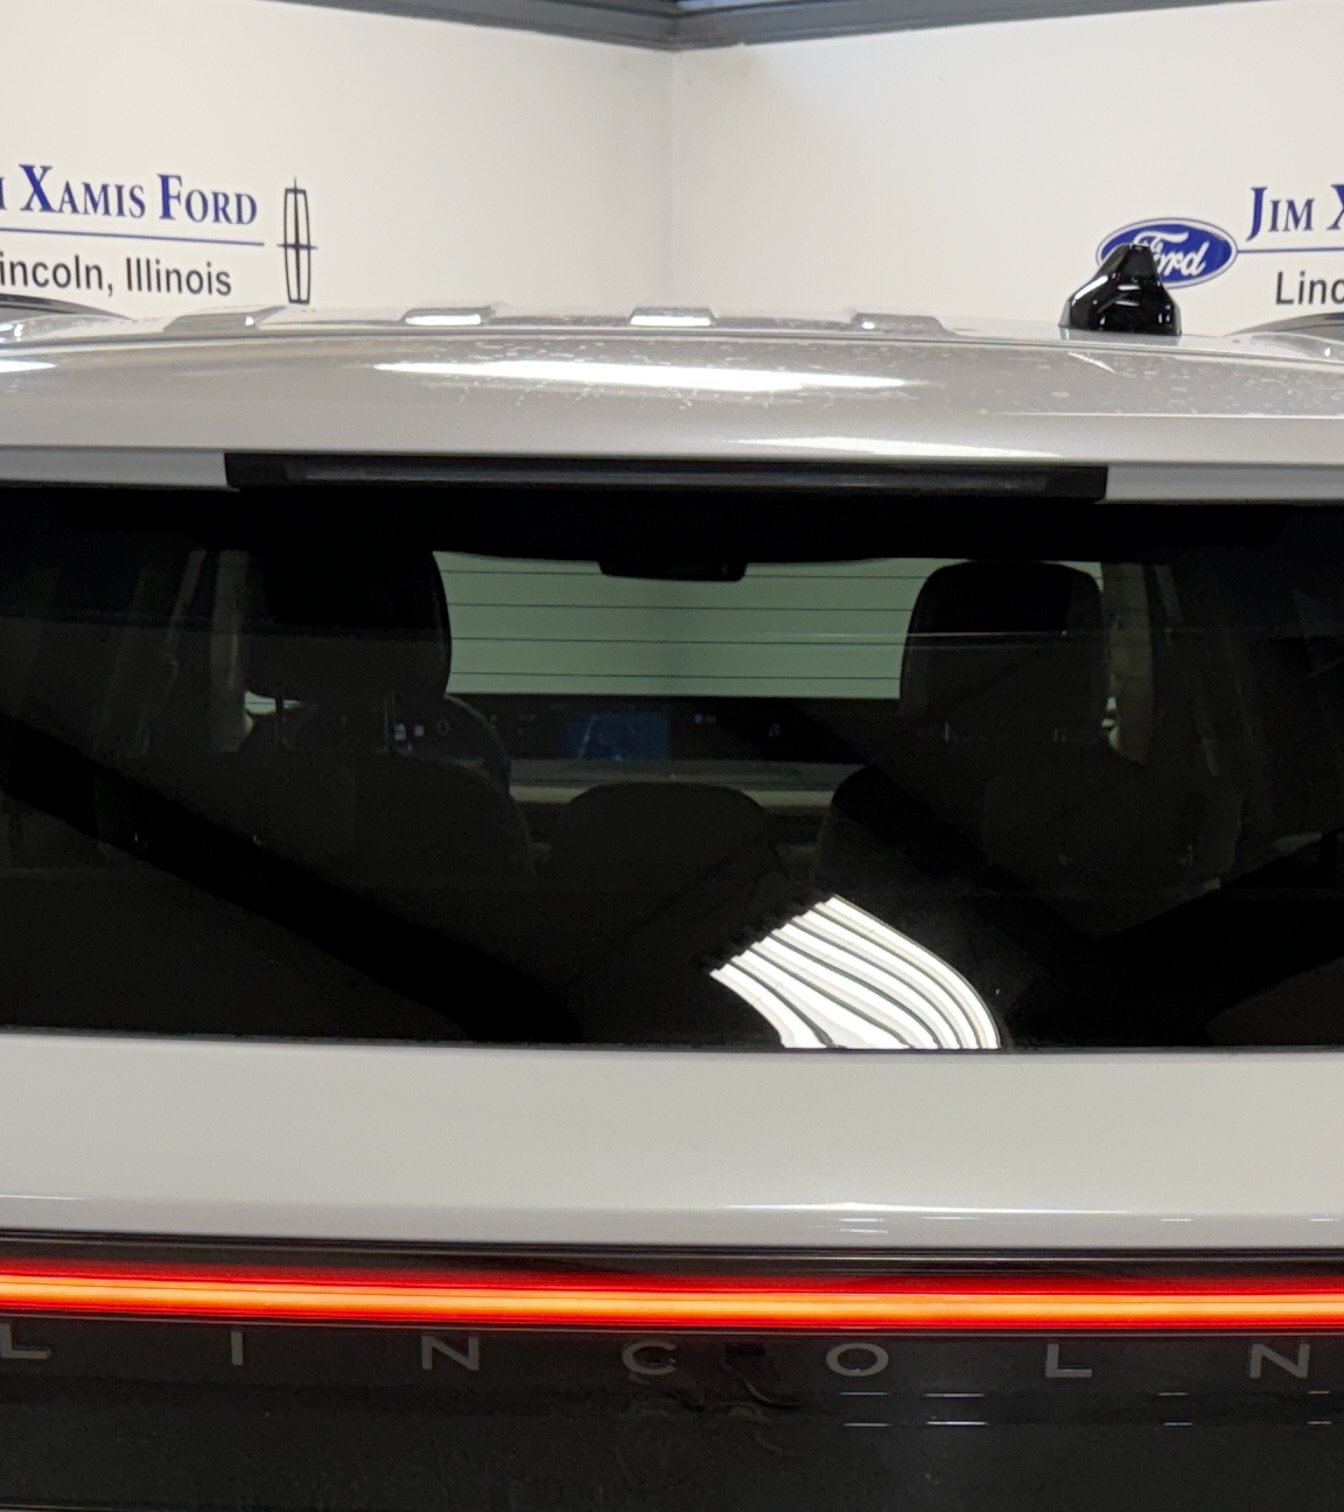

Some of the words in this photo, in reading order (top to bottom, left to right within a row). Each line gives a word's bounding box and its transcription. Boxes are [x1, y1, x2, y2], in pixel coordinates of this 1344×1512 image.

[18, 163, 146, 219] XAMIS
[157, 173, 257, 226] FORD
[1246, 186, 1315, 242] JIM
[125, 257, 232, 297] Illinois
